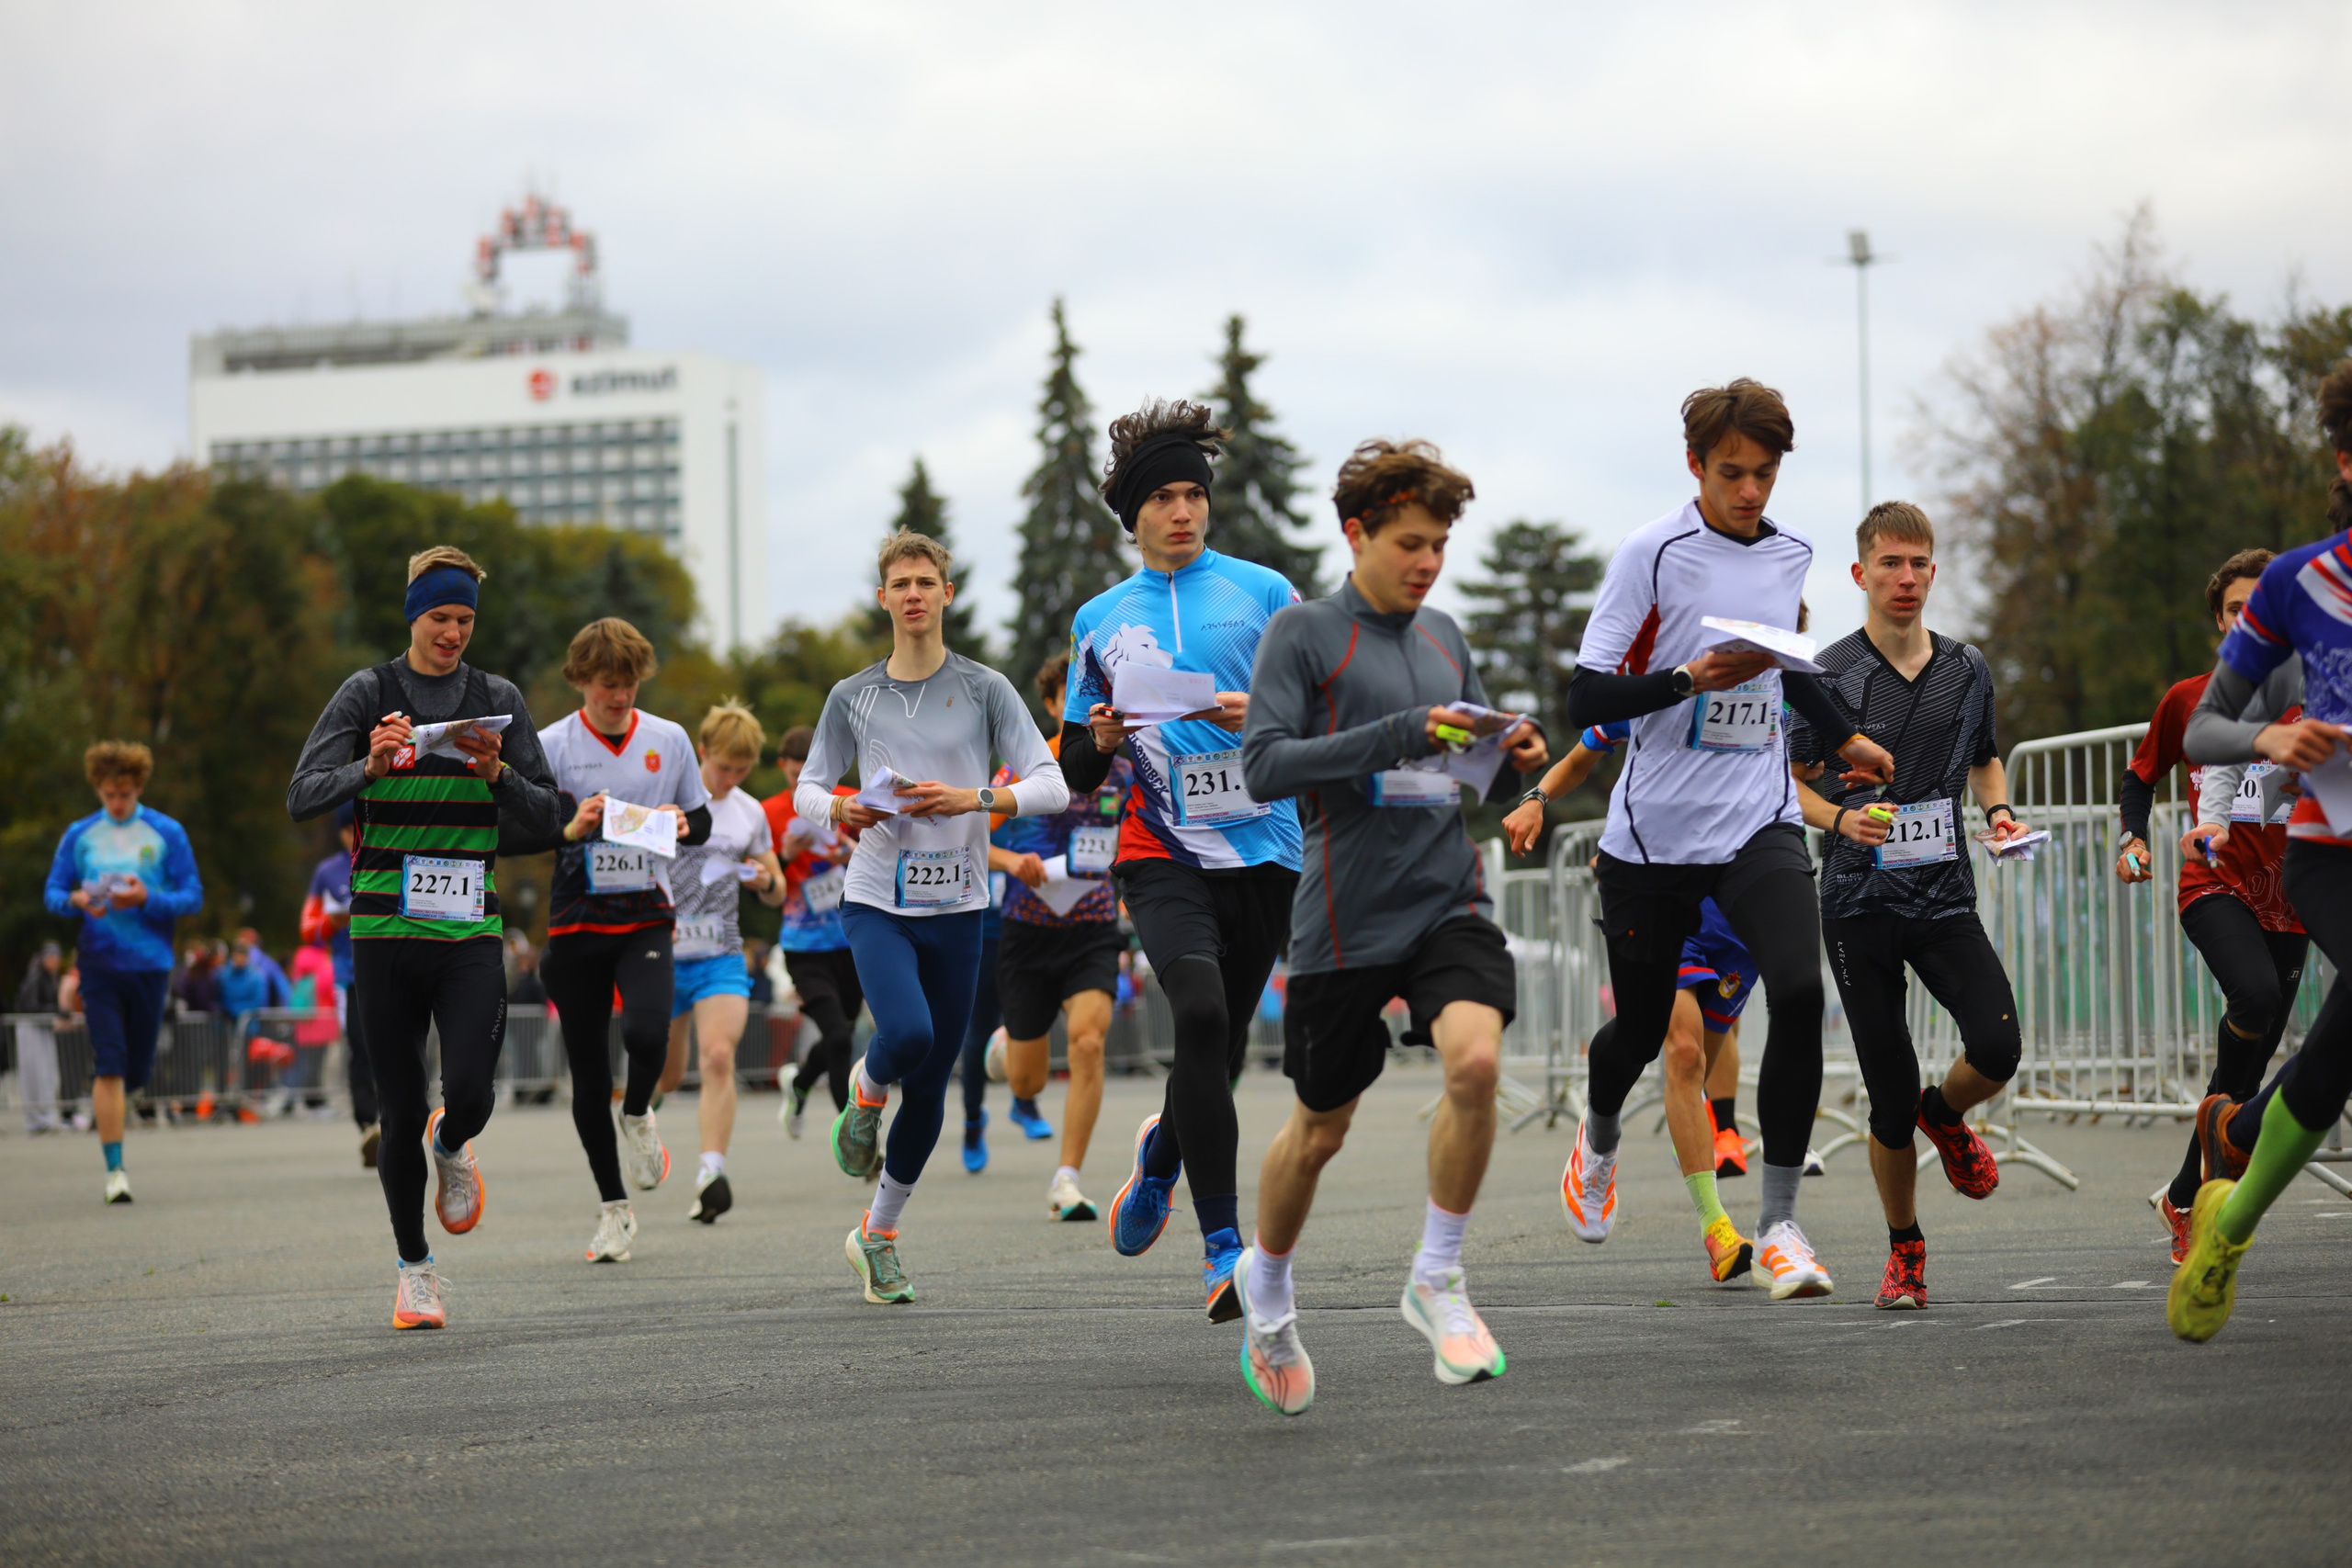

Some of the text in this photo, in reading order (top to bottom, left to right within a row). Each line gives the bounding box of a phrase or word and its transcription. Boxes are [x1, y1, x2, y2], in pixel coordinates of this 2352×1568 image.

[1706, 701, 1768, 726] 217.1
[1185, 769, 1248, 796] 231.
[1884, 817, 1942, 843] 212.1
[594, 853, 643, 872] 226.1
[907, 863, 961, 885] 222.1
[411, 873, 469, 896] 227.1
